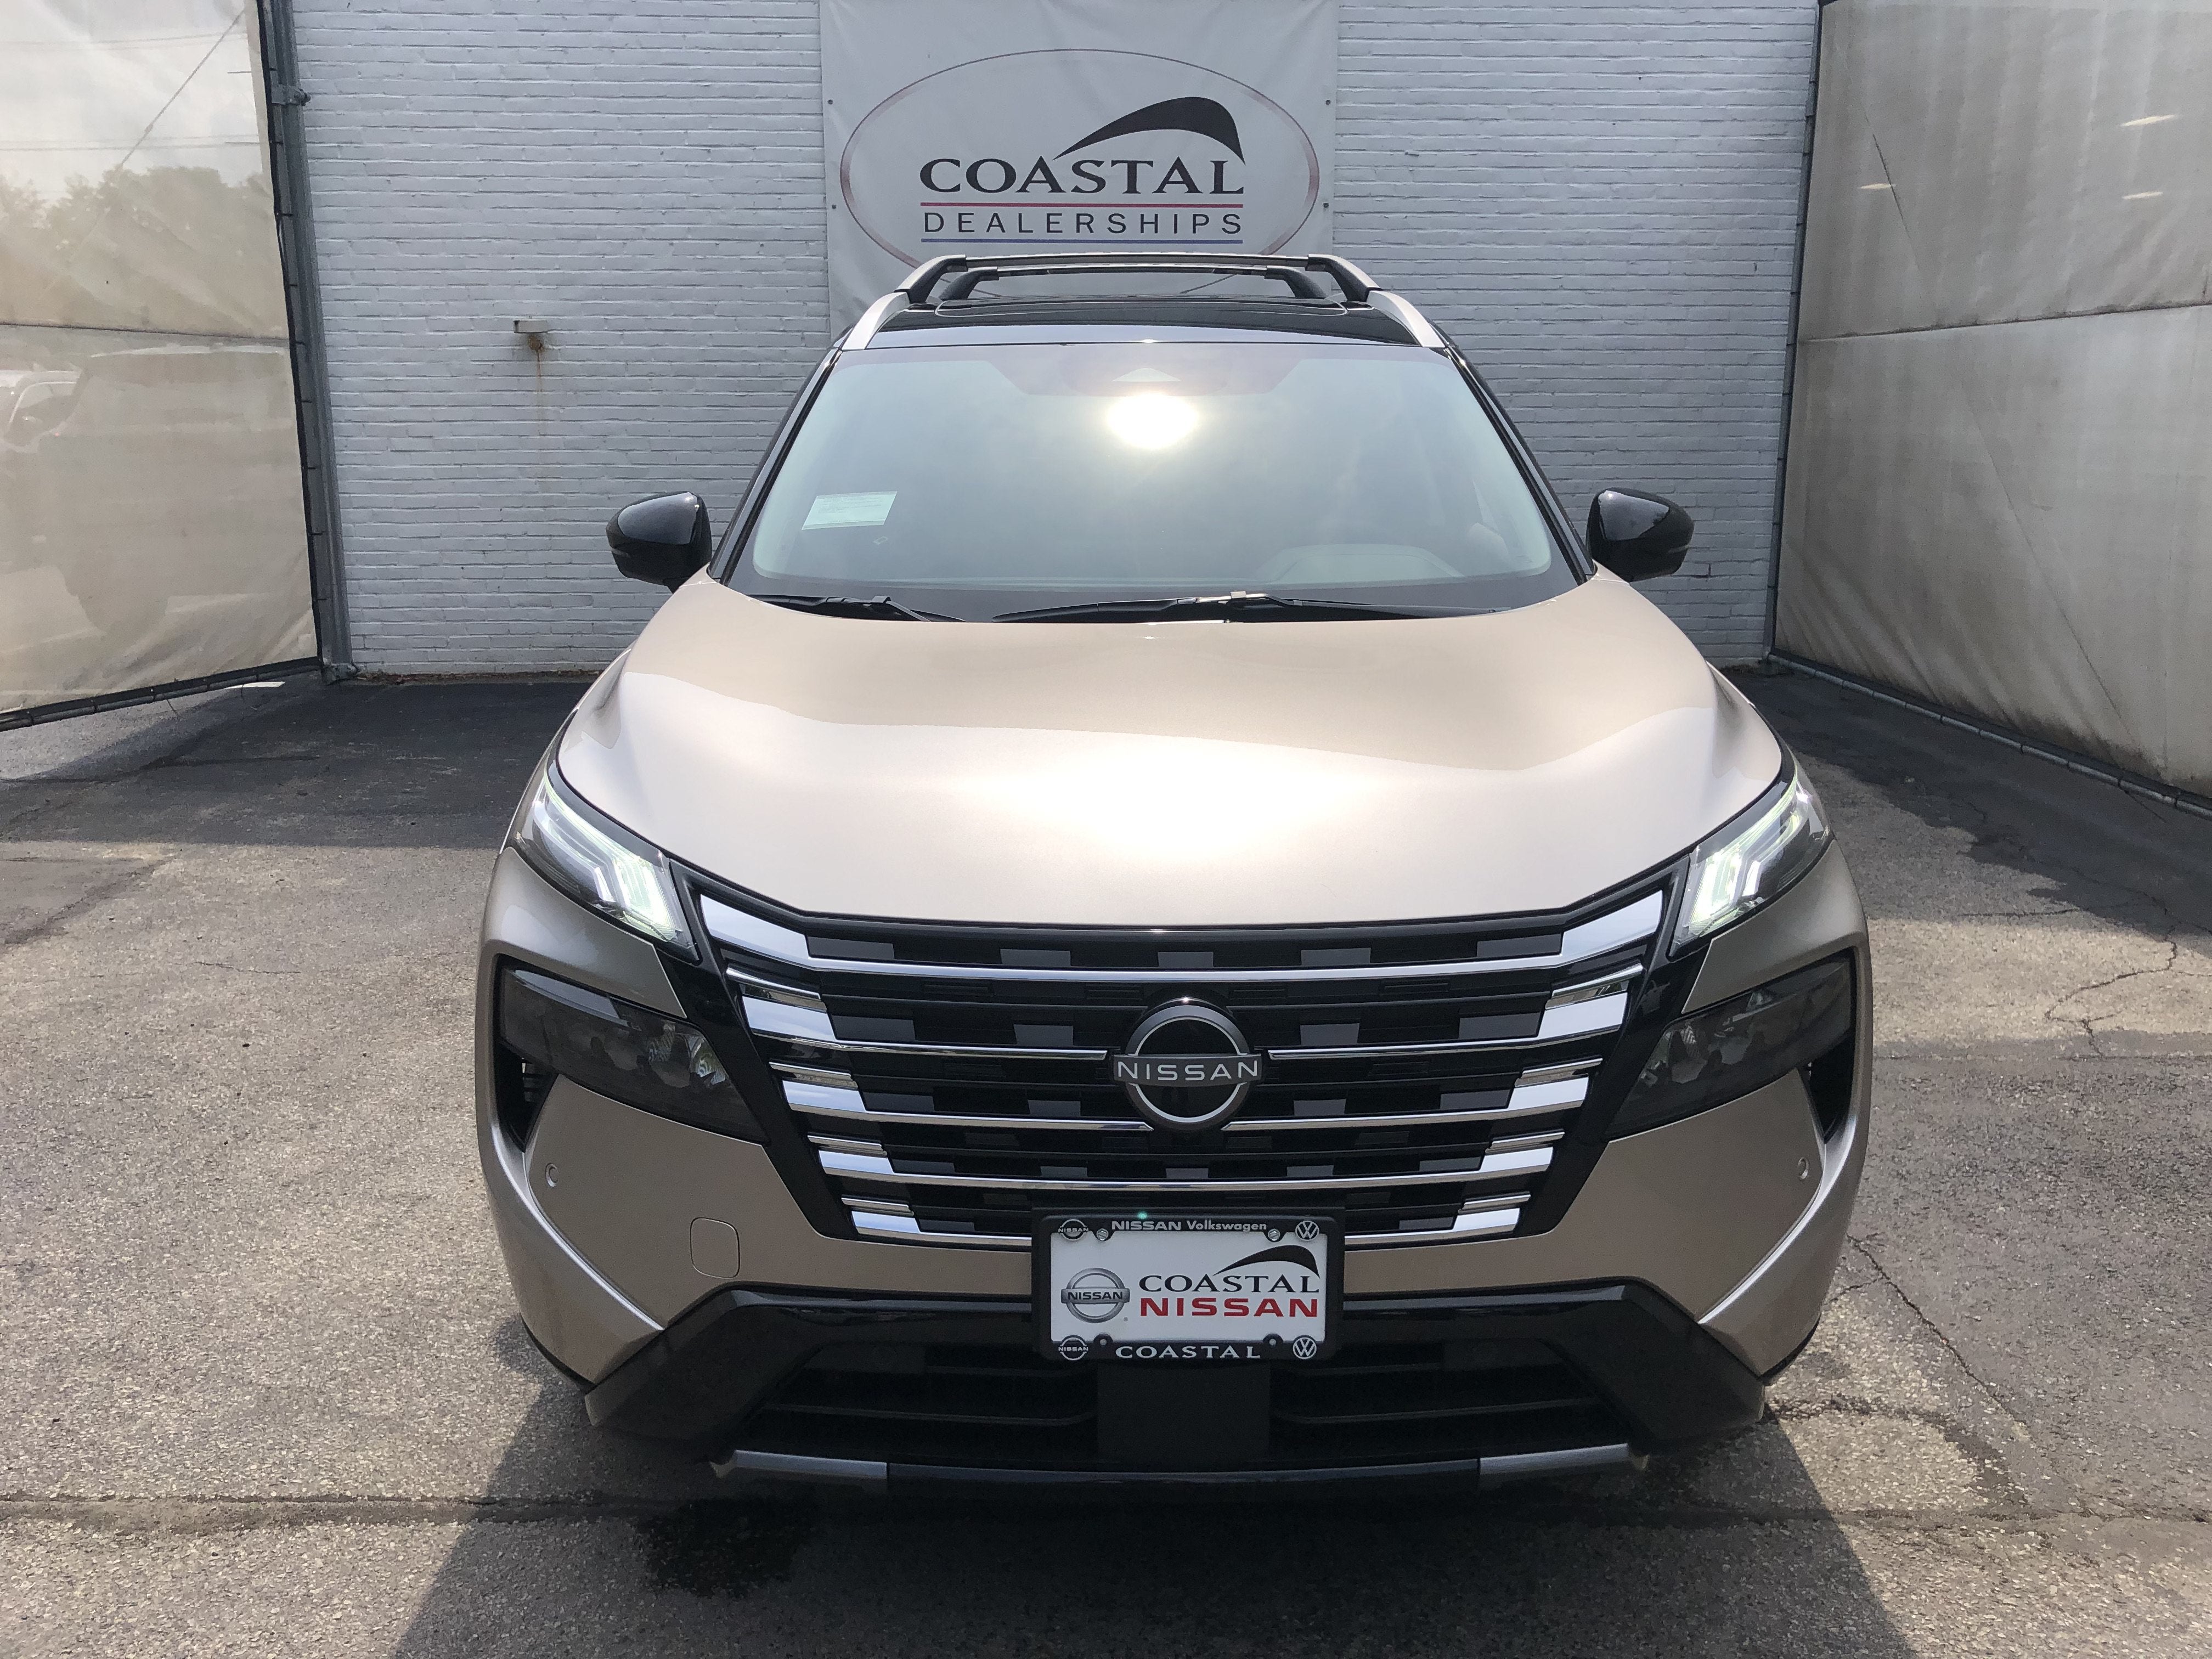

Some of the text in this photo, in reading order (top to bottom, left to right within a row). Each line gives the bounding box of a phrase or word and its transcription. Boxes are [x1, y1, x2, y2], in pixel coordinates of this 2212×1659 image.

[919, 156, 1244, 194] COASTAL
[924, 212, 1242, 234] DEALERSHIPS
[1118, 1060, 1257, 1081] NISSAN
[1111, 1220, 1267, 1232] NISSAN Volkswagen
[1139, 1273, 1319, 1293] COASTAL
[1068, 1291, 1123, 1300] NISSAN
[1141, 1297, 1318, 1317] NISSAN
[1115, 1345, 1261, 1358] COASTAL
